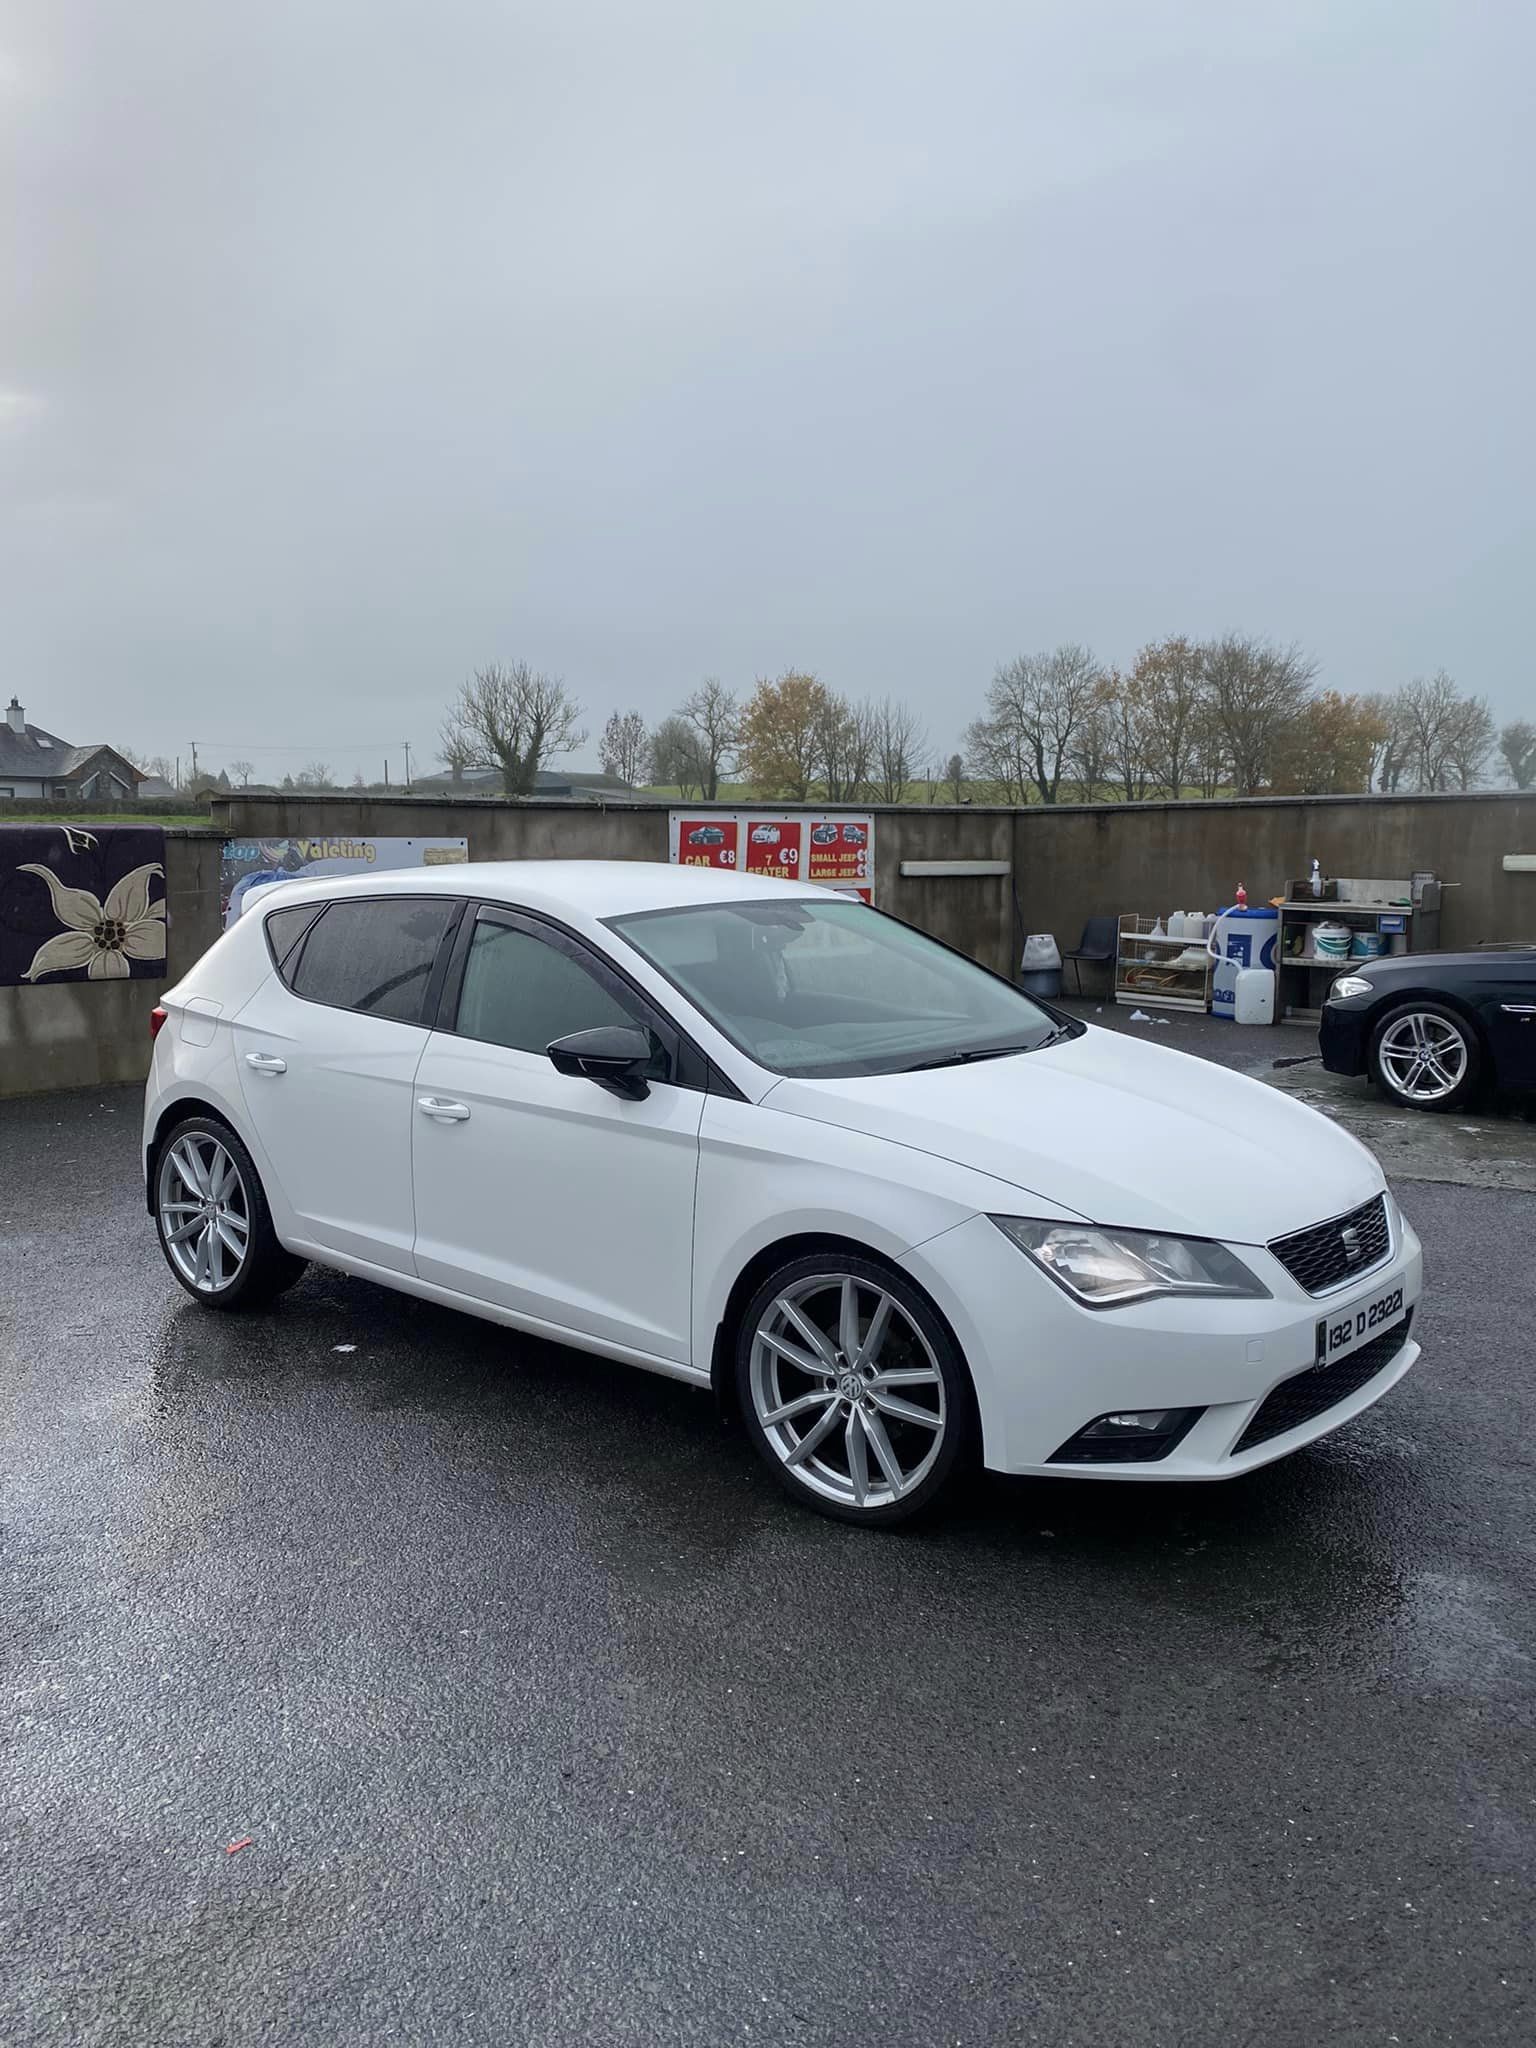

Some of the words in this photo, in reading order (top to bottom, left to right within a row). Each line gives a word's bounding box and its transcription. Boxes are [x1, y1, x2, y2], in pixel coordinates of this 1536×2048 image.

[297, 840, 376, 863] Valeting
[719, 849, 735, 864] €8
[779, 847, 798, 865] €9
[811, 853, 837, 863] SMALL
[838, 853, 856, 862] JEEP
[685, 855, 711, 867] CAR
[810, 868, 837, 877] LARGE
[838, 868, 856, 877] JEEP
[857, 863, 873, 877] €1
[1329, 1319, 1352, 1351] 132
[1356, 1311, 1366, 1336] D
[1368, 1287, 1403, 1328] 23221
